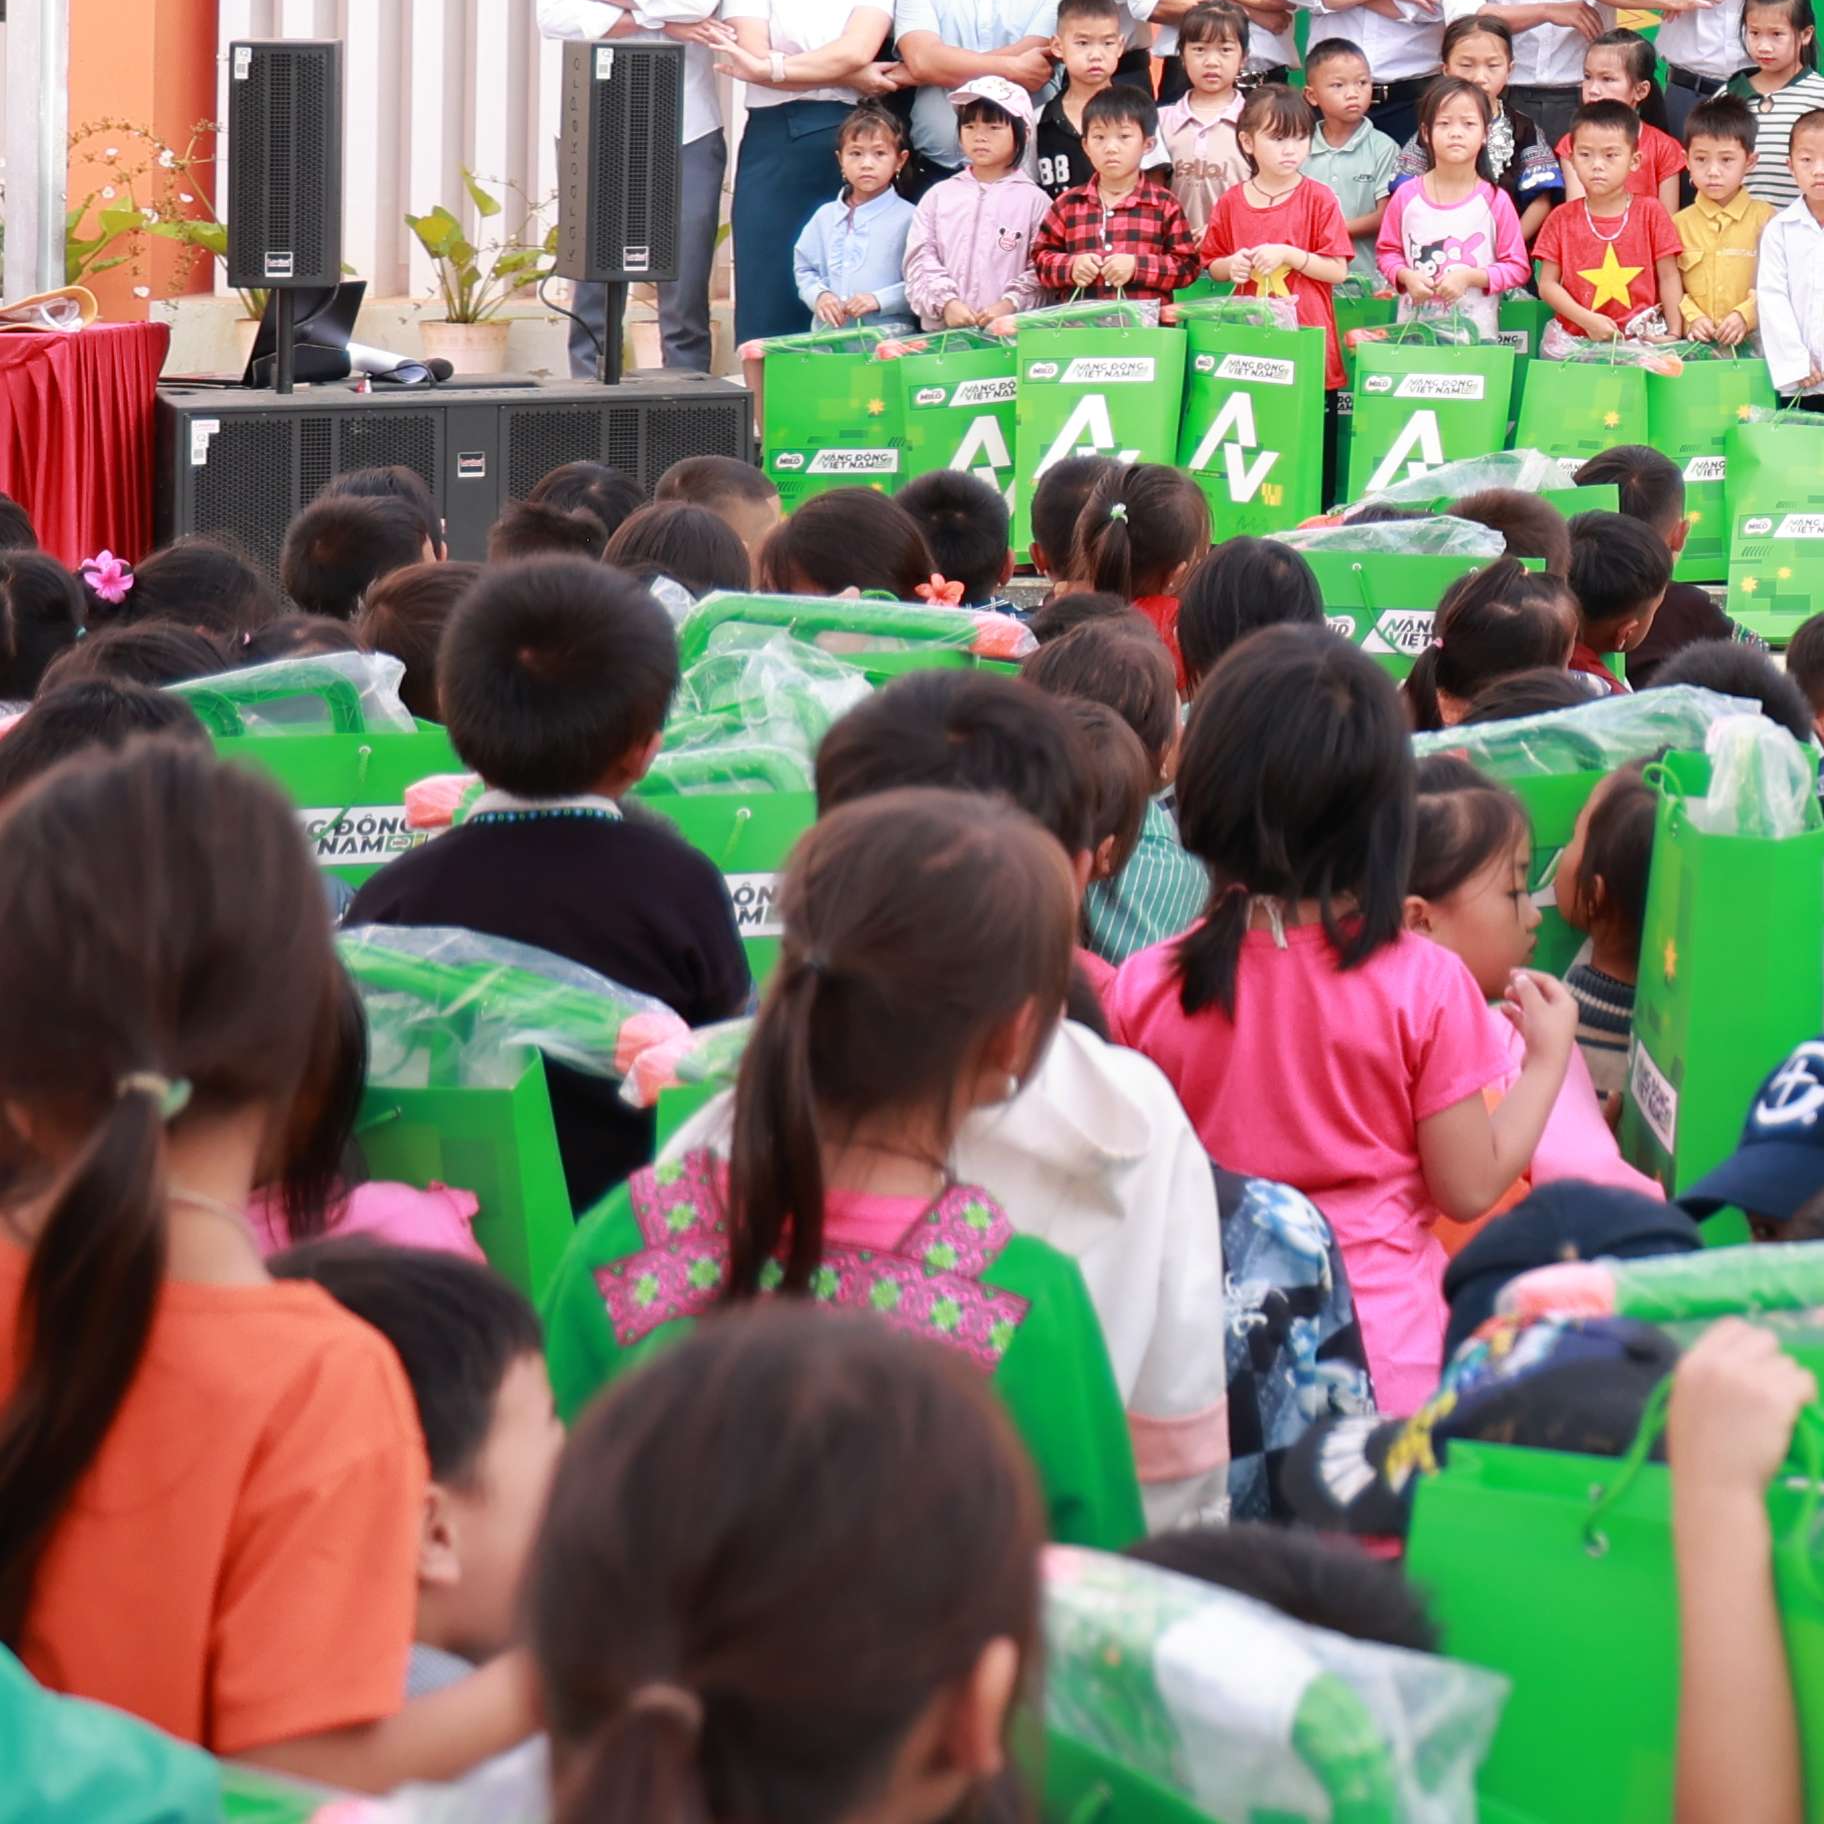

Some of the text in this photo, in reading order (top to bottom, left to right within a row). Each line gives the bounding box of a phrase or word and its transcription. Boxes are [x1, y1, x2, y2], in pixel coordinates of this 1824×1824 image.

[1039, 154, 1070, 186] 88
[1382, 616, 1432, 635] NĂN
[317, 836, 385, 856] NAM
